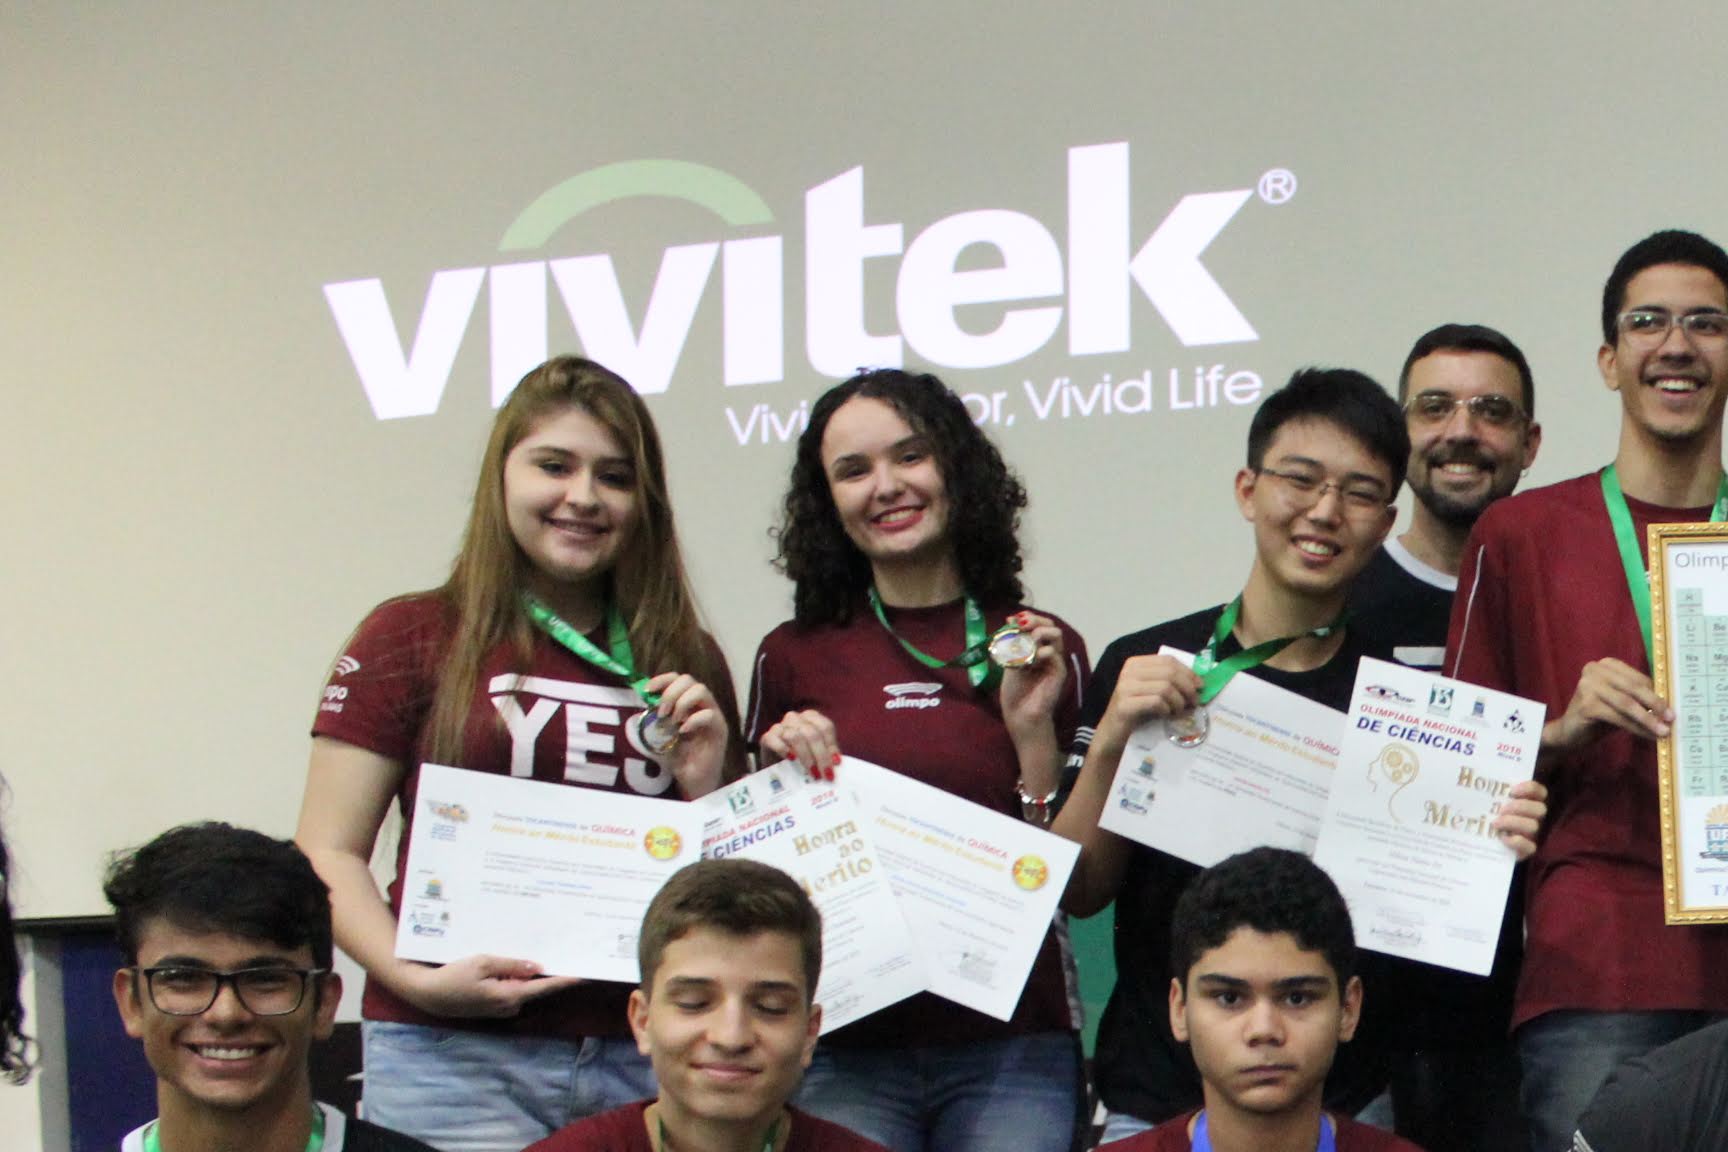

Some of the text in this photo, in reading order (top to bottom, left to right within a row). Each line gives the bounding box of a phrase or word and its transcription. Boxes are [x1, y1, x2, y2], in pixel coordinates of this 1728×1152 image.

[324, 141, 1260, 421] vivitek
[726, 400, 810, 446] Vivi
[1024, 372, 1151, 420] Vivid
[1168, 364, 1265, 411] Life
[885, 696, 941, 710] olimpo
[1360, 702, 1479, 740] OLIMPÍADA NACIONAL
[490, 694, 674, 796] YES
[1303, 735, 1341, 757] QUÍMIC
[1356, 716, 1477, 757] DE CIÊNCIAS
[1456, 764, 1514, 798] Honr
[739, 805, 791, 832] NACIONAL
[792, 819, 858, 857] Honra
[839, 837, 865, 859] ao
